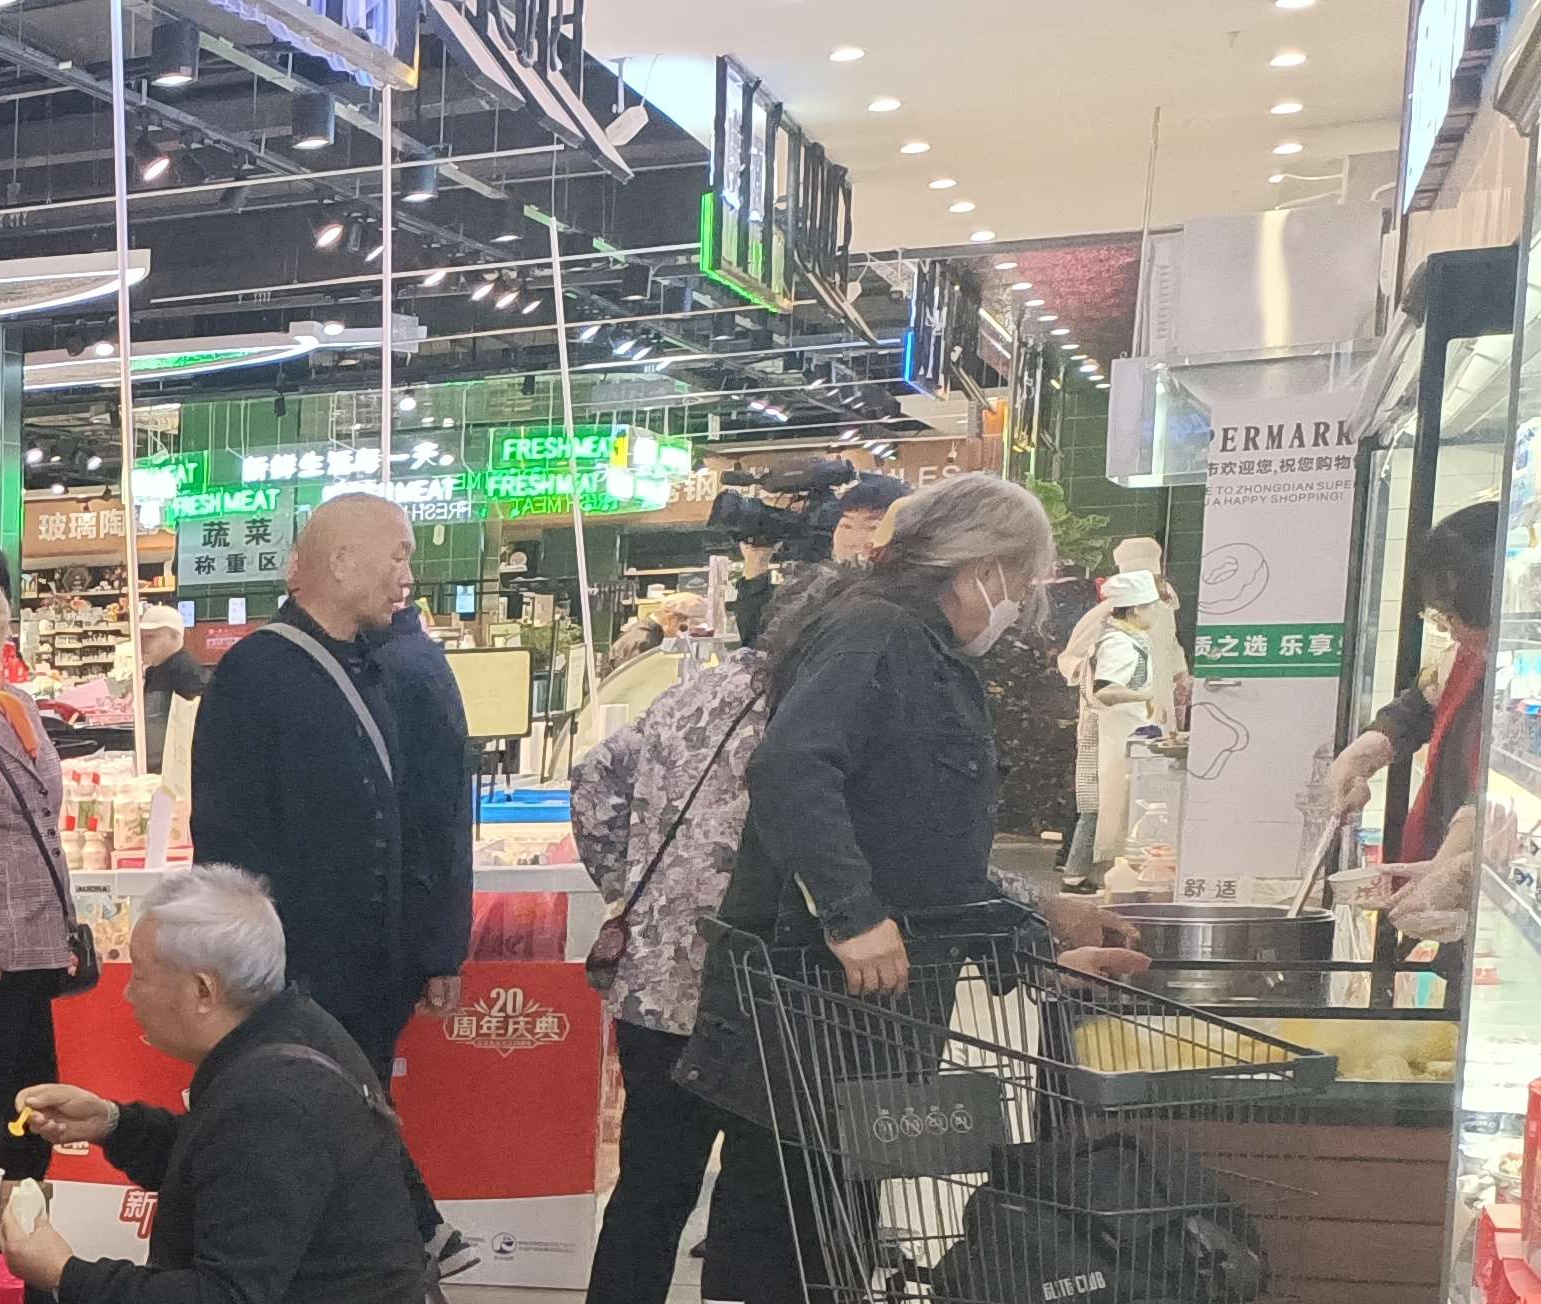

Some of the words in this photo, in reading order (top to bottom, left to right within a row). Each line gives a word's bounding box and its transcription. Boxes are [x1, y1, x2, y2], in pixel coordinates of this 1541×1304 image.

[1208, 420, 1356, 453] ERMARK
[503, 436, 566, 462] FRESH
[1207, 455, 1358, 477] 市欢迎您,祝您购物
[223, 488, 280, 512] MEAT
[1217, 485, 1236, 495] TO
[1237, 482, 1314, 494] ZHONGDIAN
[1224, 495, 1267, 505] HAPPY
[38, 508, 159, 541] 玻璃陶
[201, 517, 273, 548] 蔬菜
[194, 552, 278, 576] 称重区
[1279, 633, 1343, 656] 乐享
[1184, 878, 1237, 899] 舒适
[490, 988, 524, 1016] 20
[452, 1015, 560, 1041] 周年庆典
[1075, 1271, 1106, 1293] CLUB
